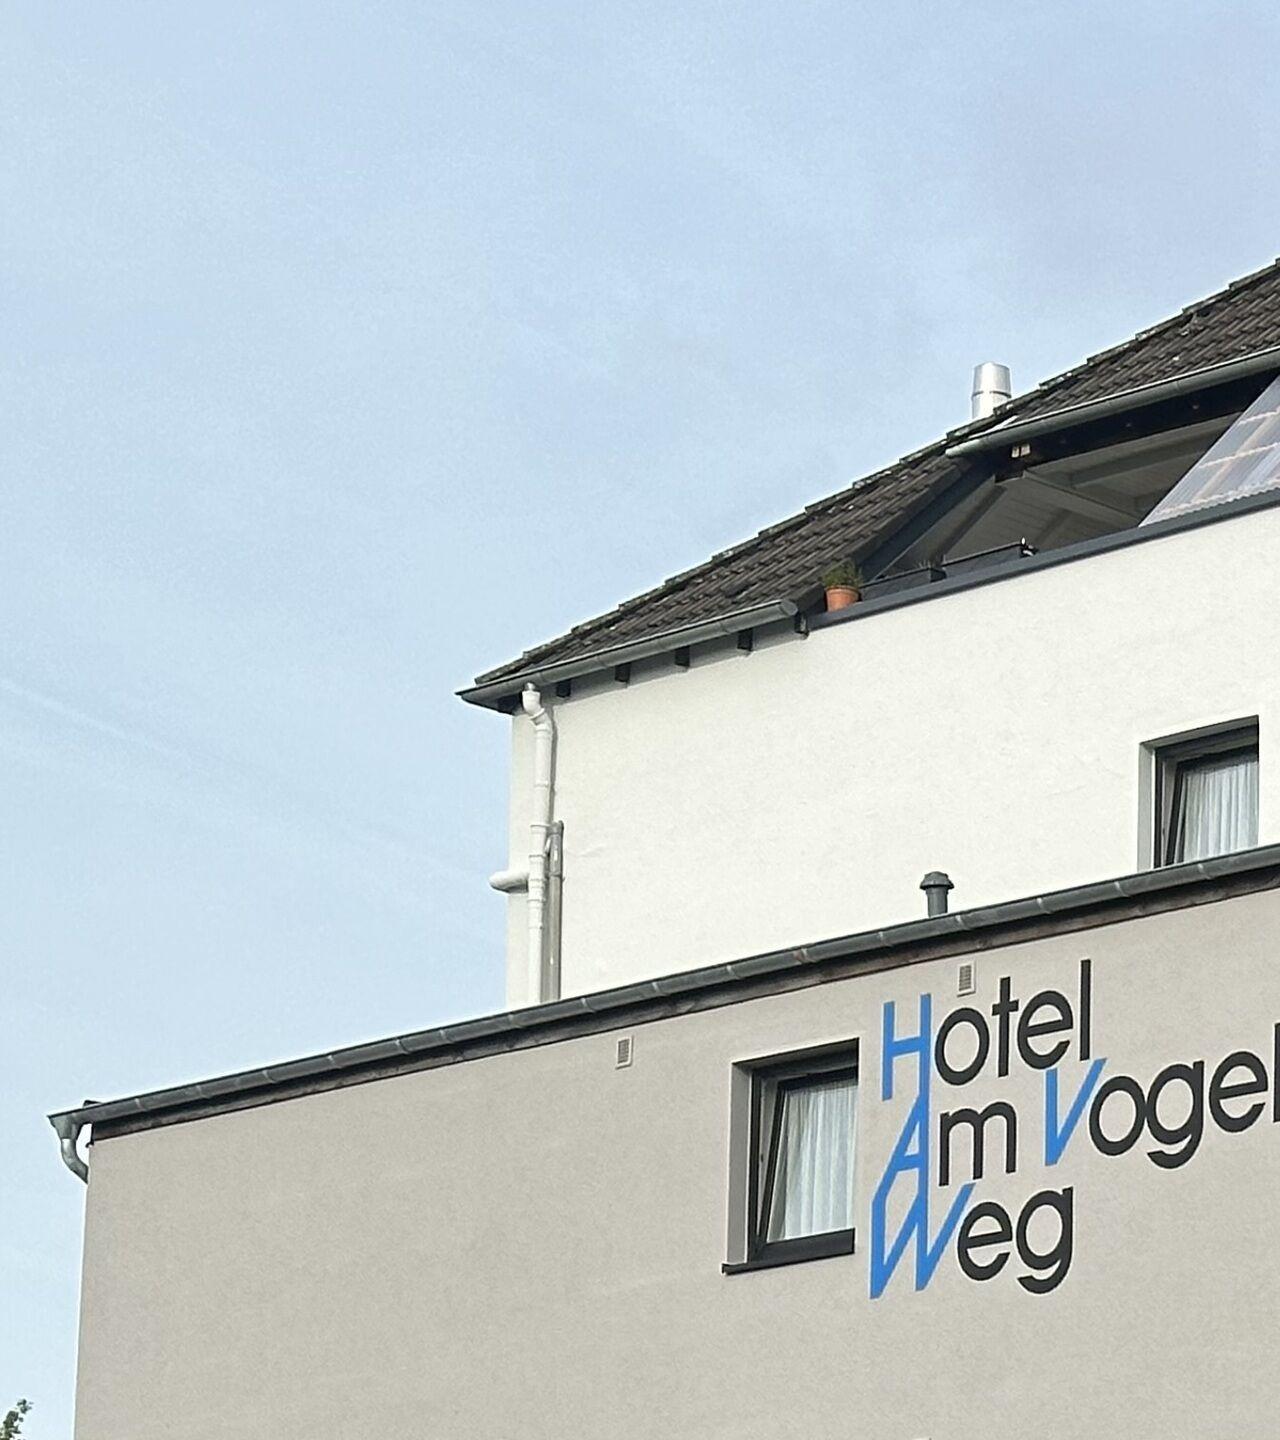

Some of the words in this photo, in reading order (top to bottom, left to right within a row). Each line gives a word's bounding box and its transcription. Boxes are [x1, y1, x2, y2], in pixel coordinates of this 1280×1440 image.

[881, 958, 1092, 1101] Hotel
[873, 1090, 1018, 1200] Am
[869, 1182, 1074, 1299] Weg
